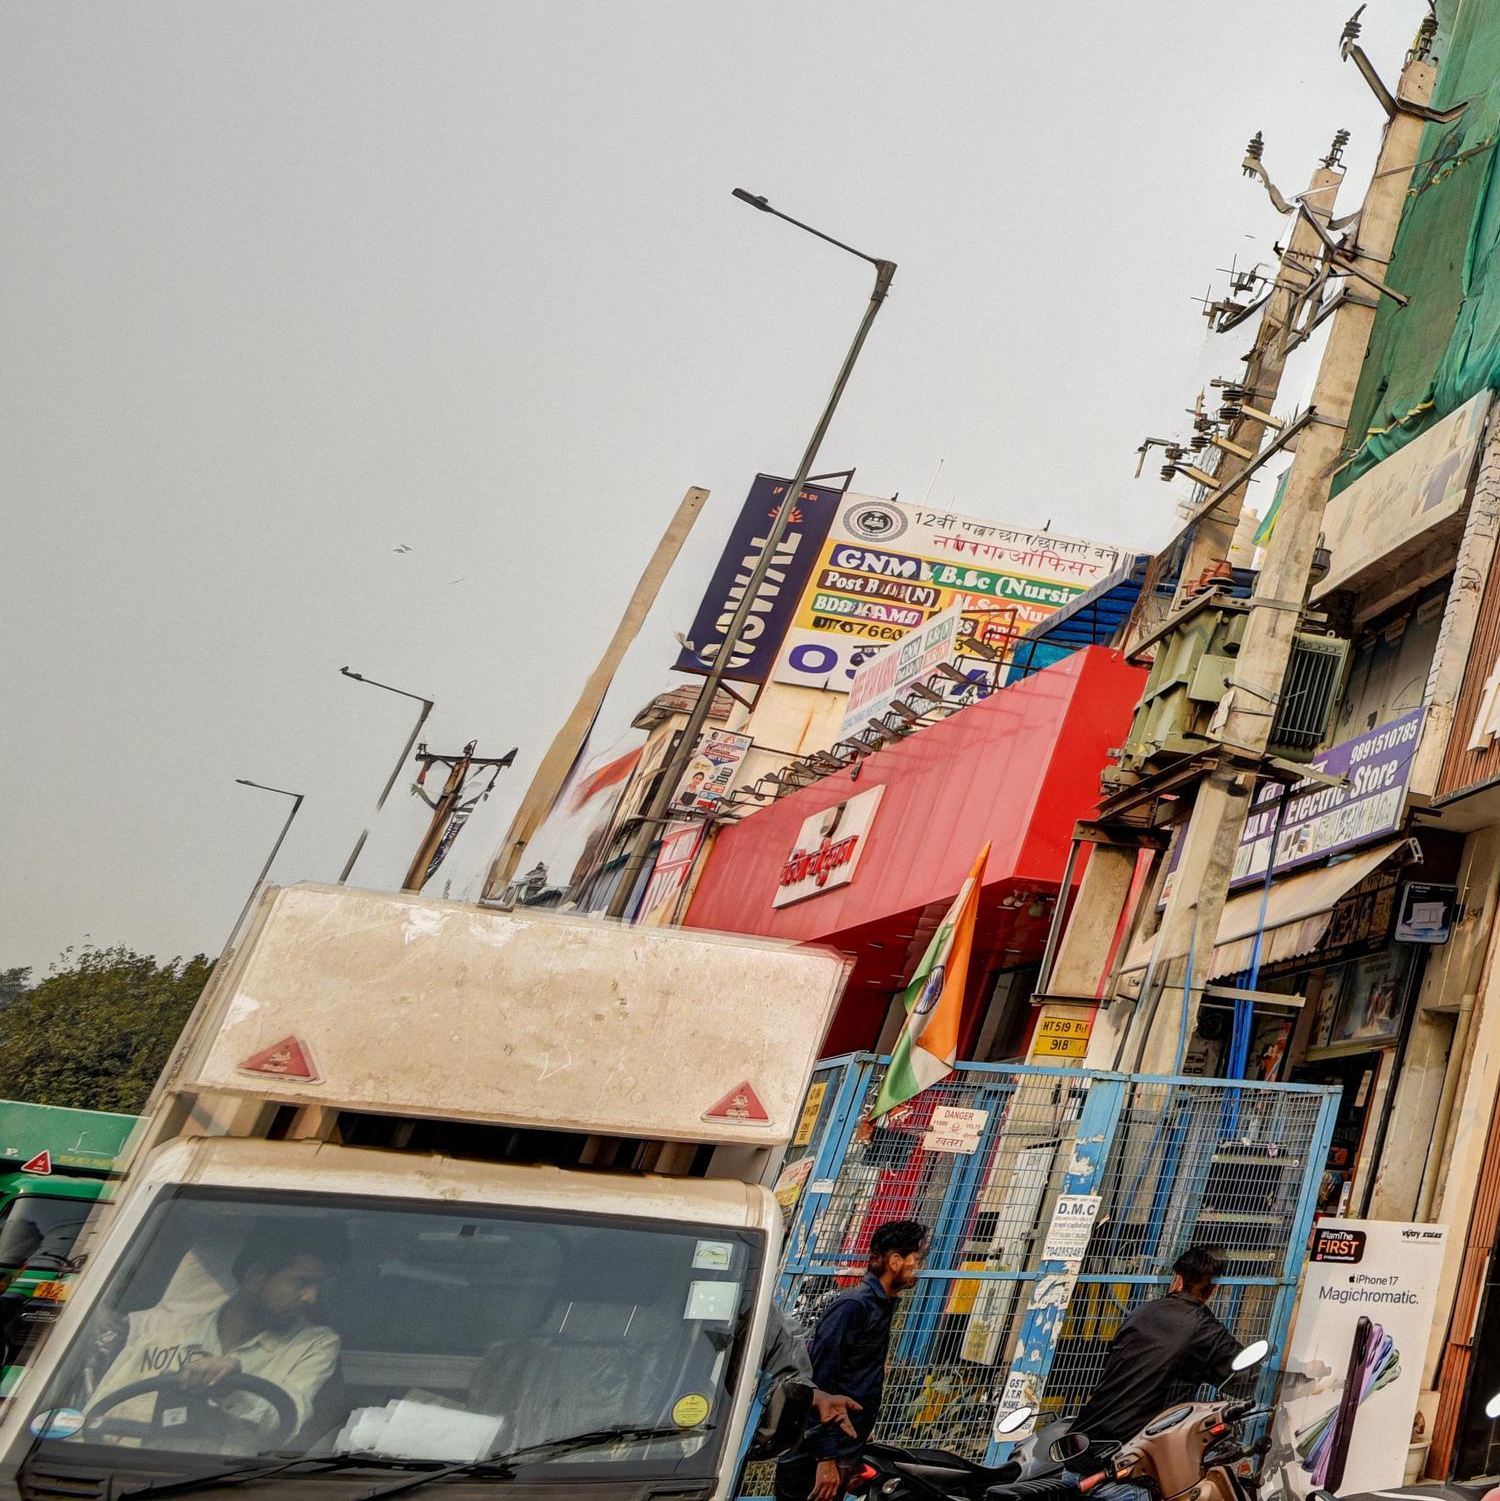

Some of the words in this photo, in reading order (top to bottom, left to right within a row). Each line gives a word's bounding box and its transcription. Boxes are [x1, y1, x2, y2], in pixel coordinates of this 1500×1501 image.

[836, 548, 918, 580] GNM
[824, 573, 865, 594] Post
[1350, 718, 1419, 765] 9891510785
[1351, 759, 1399, 798] Store
[944, 1109, 975, 1121] DANGER
[1057, 1202, 1096, 1216] D.M.C
[1317, 1240, 1359, 1255] FIRST
[1356, 1274, 1388, 1286] iPhone
[1389, 1276, 1399, 1286] 17
[1318, 1285, 1420, 1305] Magichromatic.
[1009, 1378, 1026, 1389] GST
